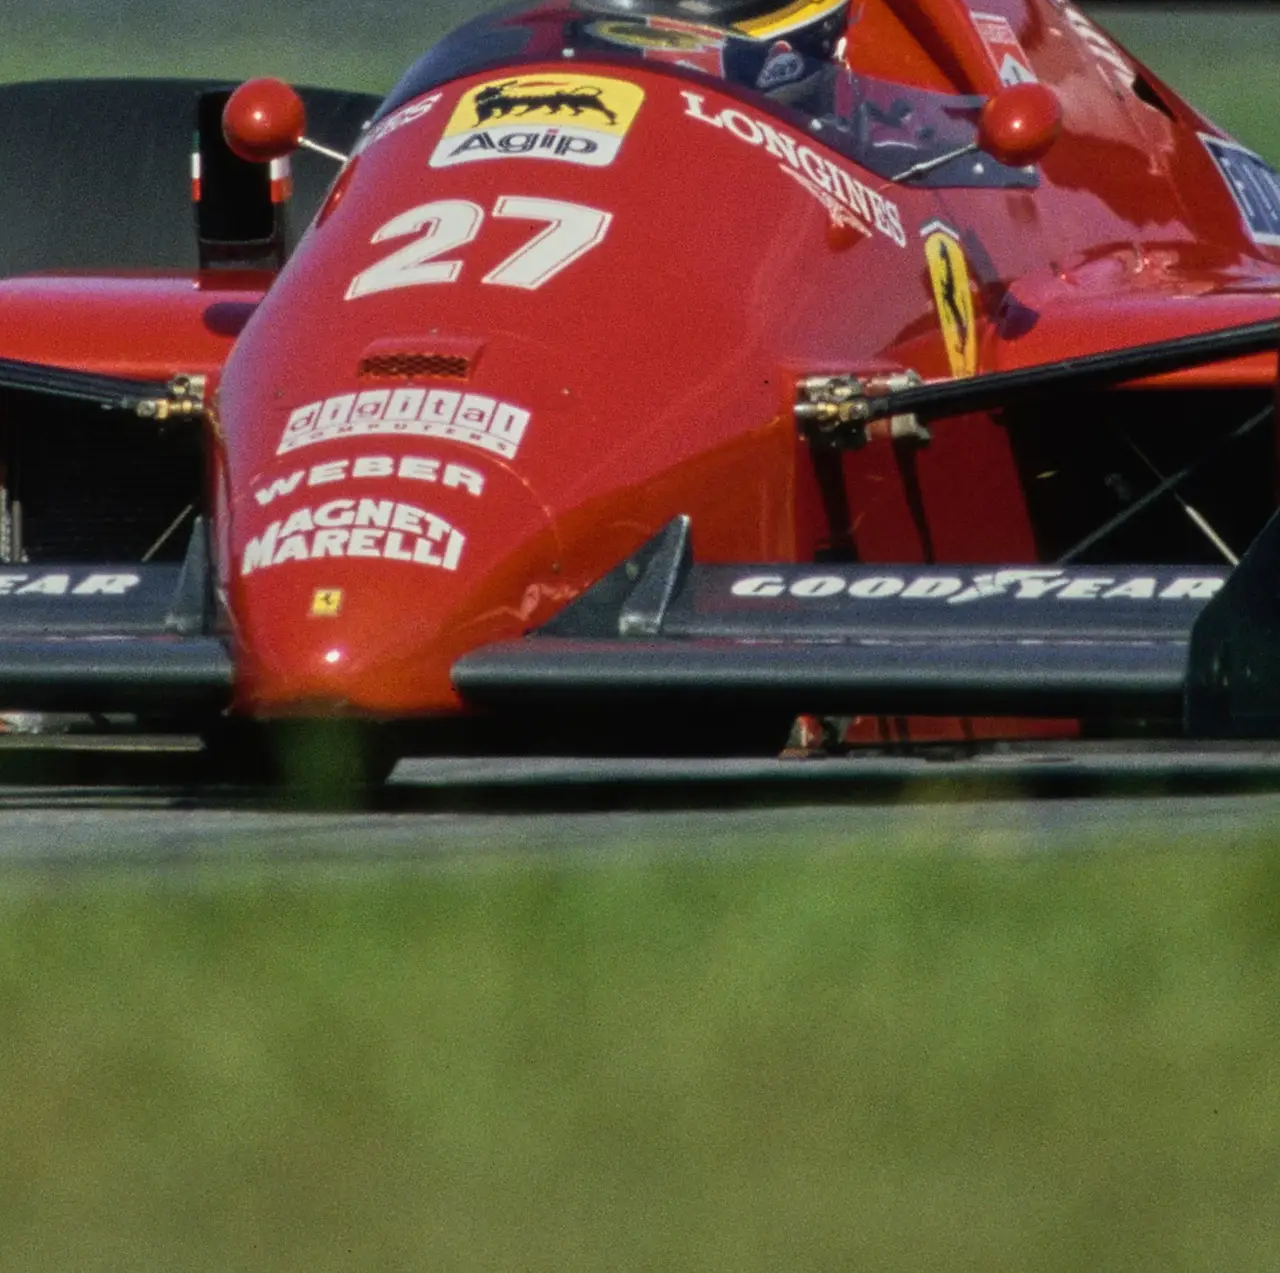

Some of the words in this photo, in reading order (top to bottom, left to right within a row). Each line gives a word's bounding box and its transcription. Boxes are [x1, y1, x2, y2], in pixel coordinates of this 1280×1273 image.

[447, 128, 599, 158] Agip
[680, 90, 906, 248] LONGINES
[344, 195, 614, 301] 27
[290, 393, 517, 434] digital
[254, 455, 486, 506] WEBER
[240, 520, 467, 576] MARELLI
